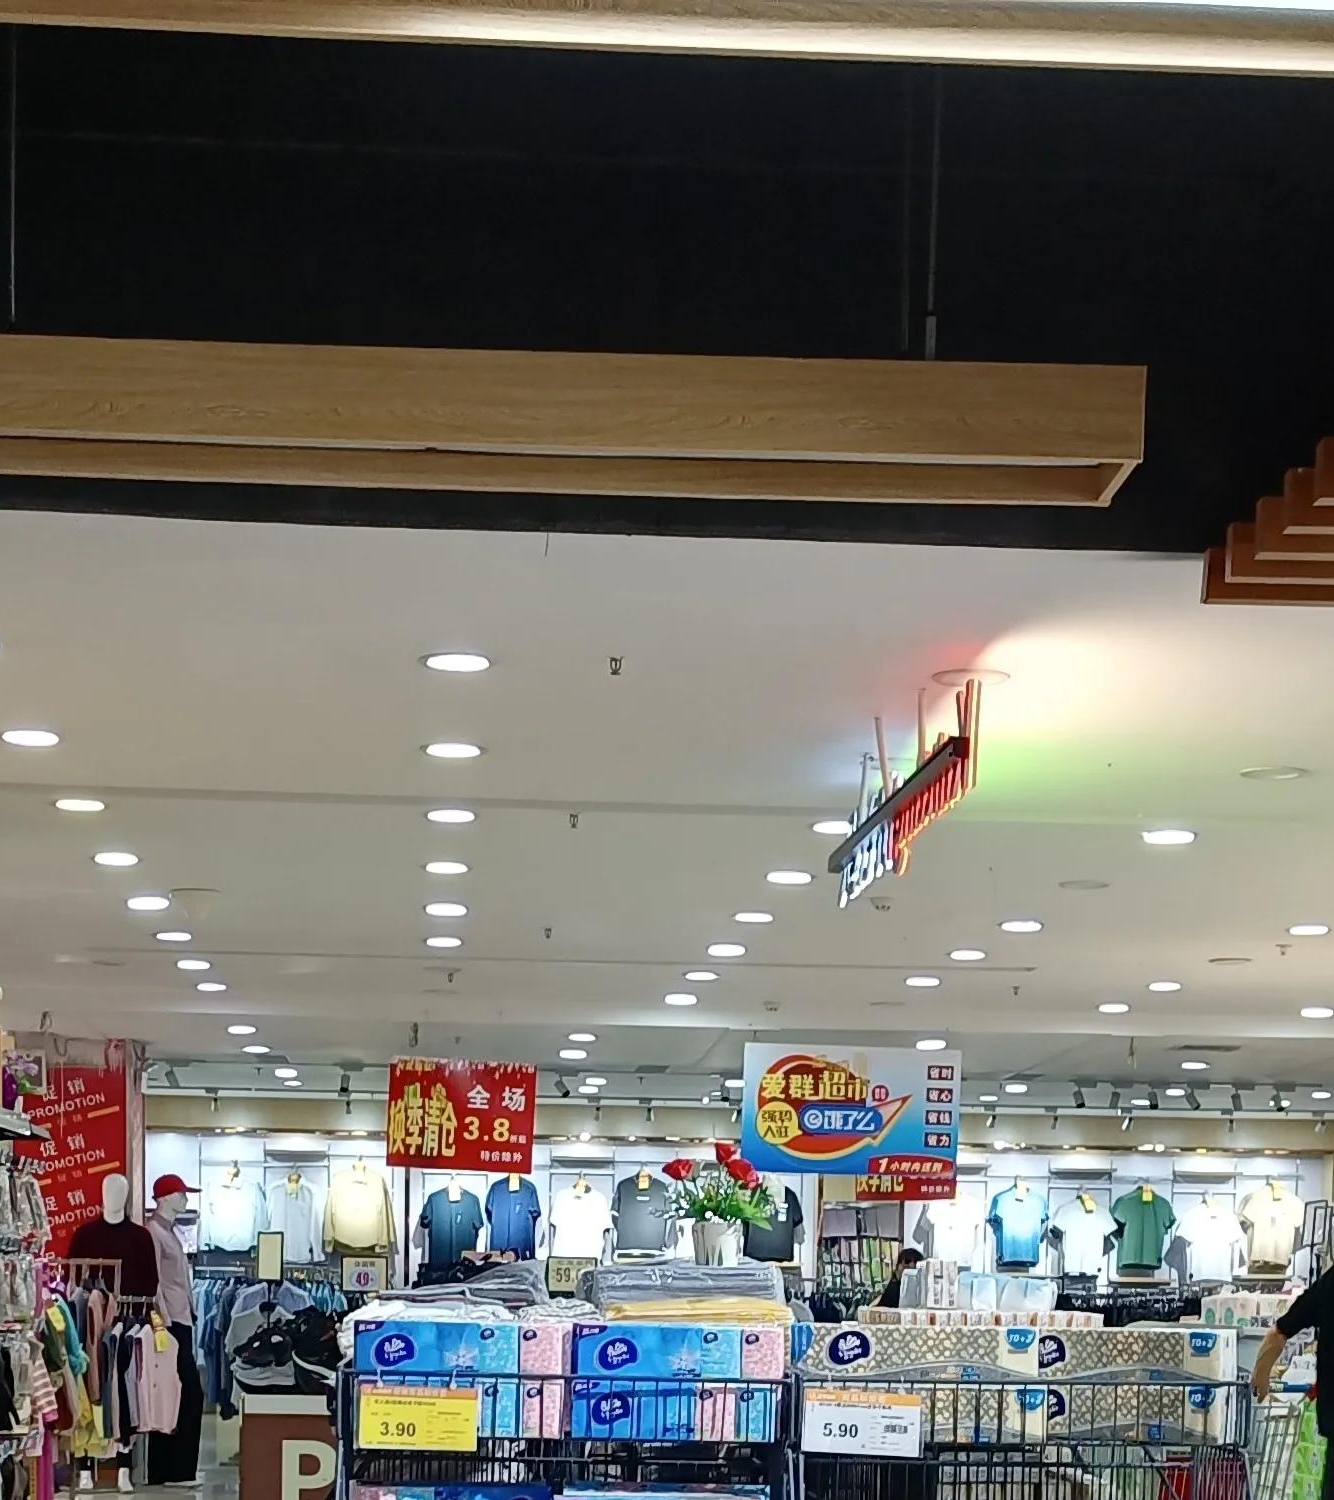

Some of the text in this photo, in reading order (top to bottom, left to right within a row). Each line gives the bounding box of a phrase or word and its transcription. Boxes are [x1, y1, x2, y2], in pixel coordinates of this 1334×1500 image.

[28, 1091, 106, 1121] PROMOTION
[467, 1084, 526, 1112] 全场
[40, 1133, 85, 1158] 促销
[379, 1421, 417, 1438] 3.90
[822, 1422, 859, 1439] 5.90
